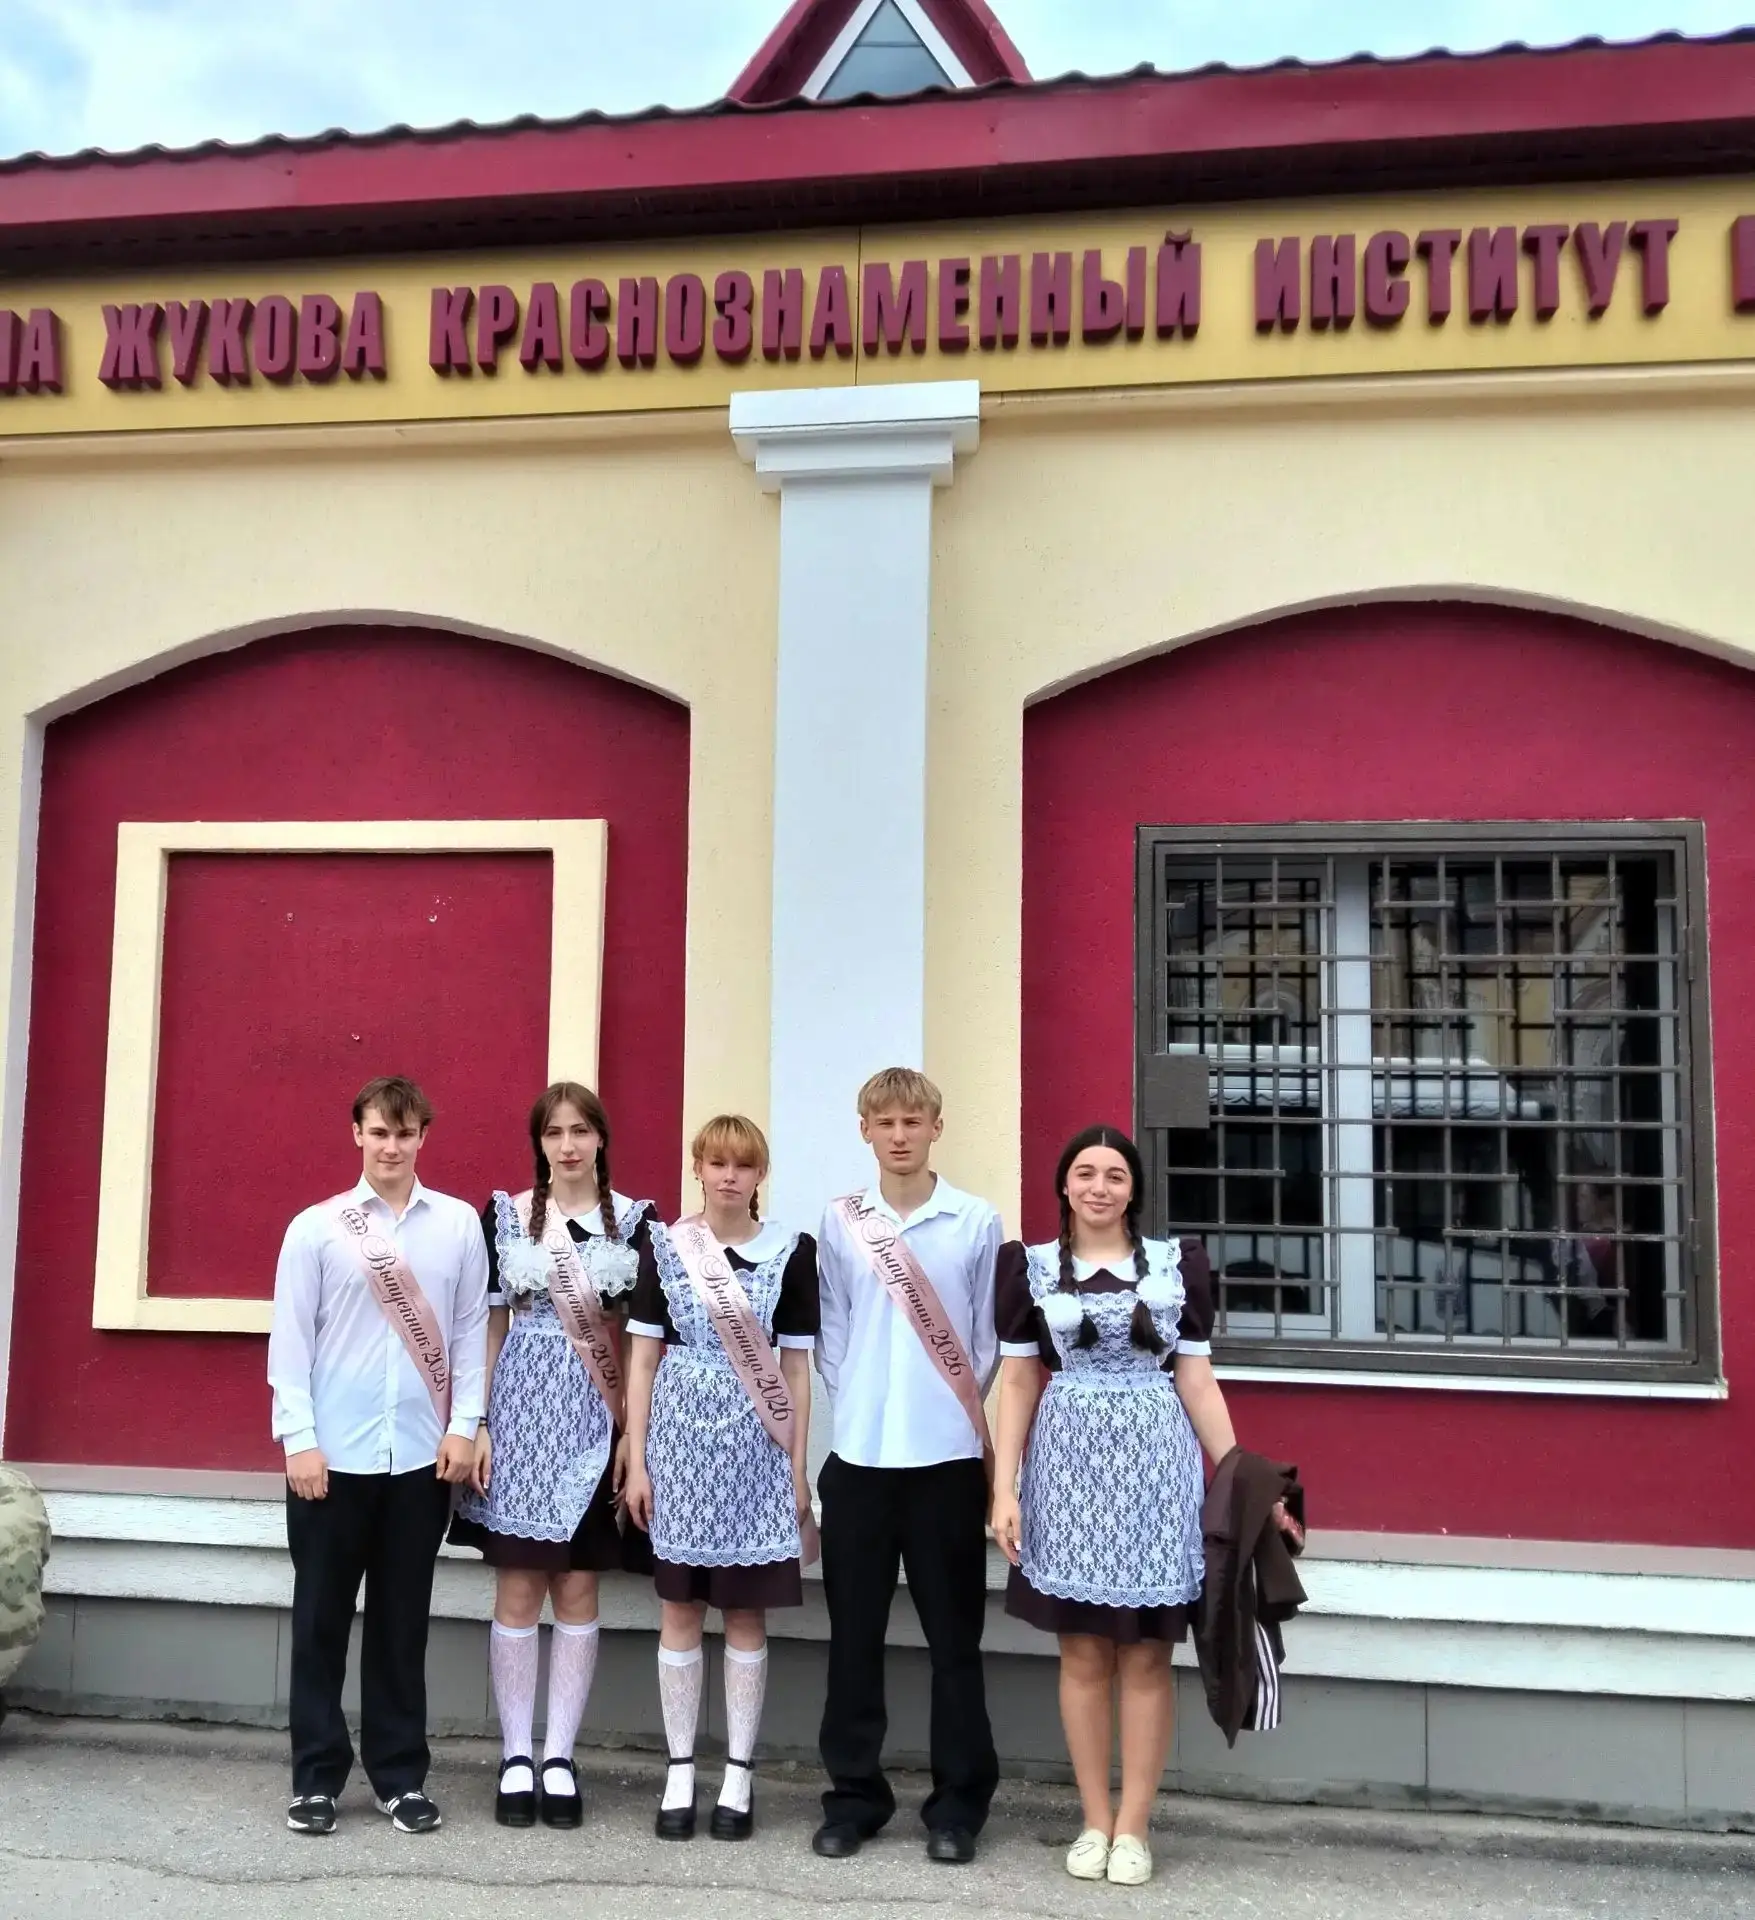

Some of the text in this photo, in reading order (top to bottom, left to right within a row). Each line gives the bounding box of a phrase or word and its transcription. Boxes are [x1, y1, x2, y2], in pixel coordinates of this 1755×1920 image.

[0, 308, 63, 395] А
[98, 291, 387, 391] ЖУКОВА
[429, 228, 1201, 375] КРАСНОЗНАМЕННЫЙ
[1254, 218, 1680, 334] ИНСТИТУТ
[361, 1234, 431, 1350] Выпускник
[421, 1346, 448, 1393] 2026
[543, 1229, 596, 1347] Выпускница
[591, 1343, 620, 1390] 2026
[697, 1254, 764, 1374] Выпускница
[753, 1373, 794, 1422] 2026
[861, 1216, 934, 1331] Выпускник
[928, 1329, 967, 1377] 2026
